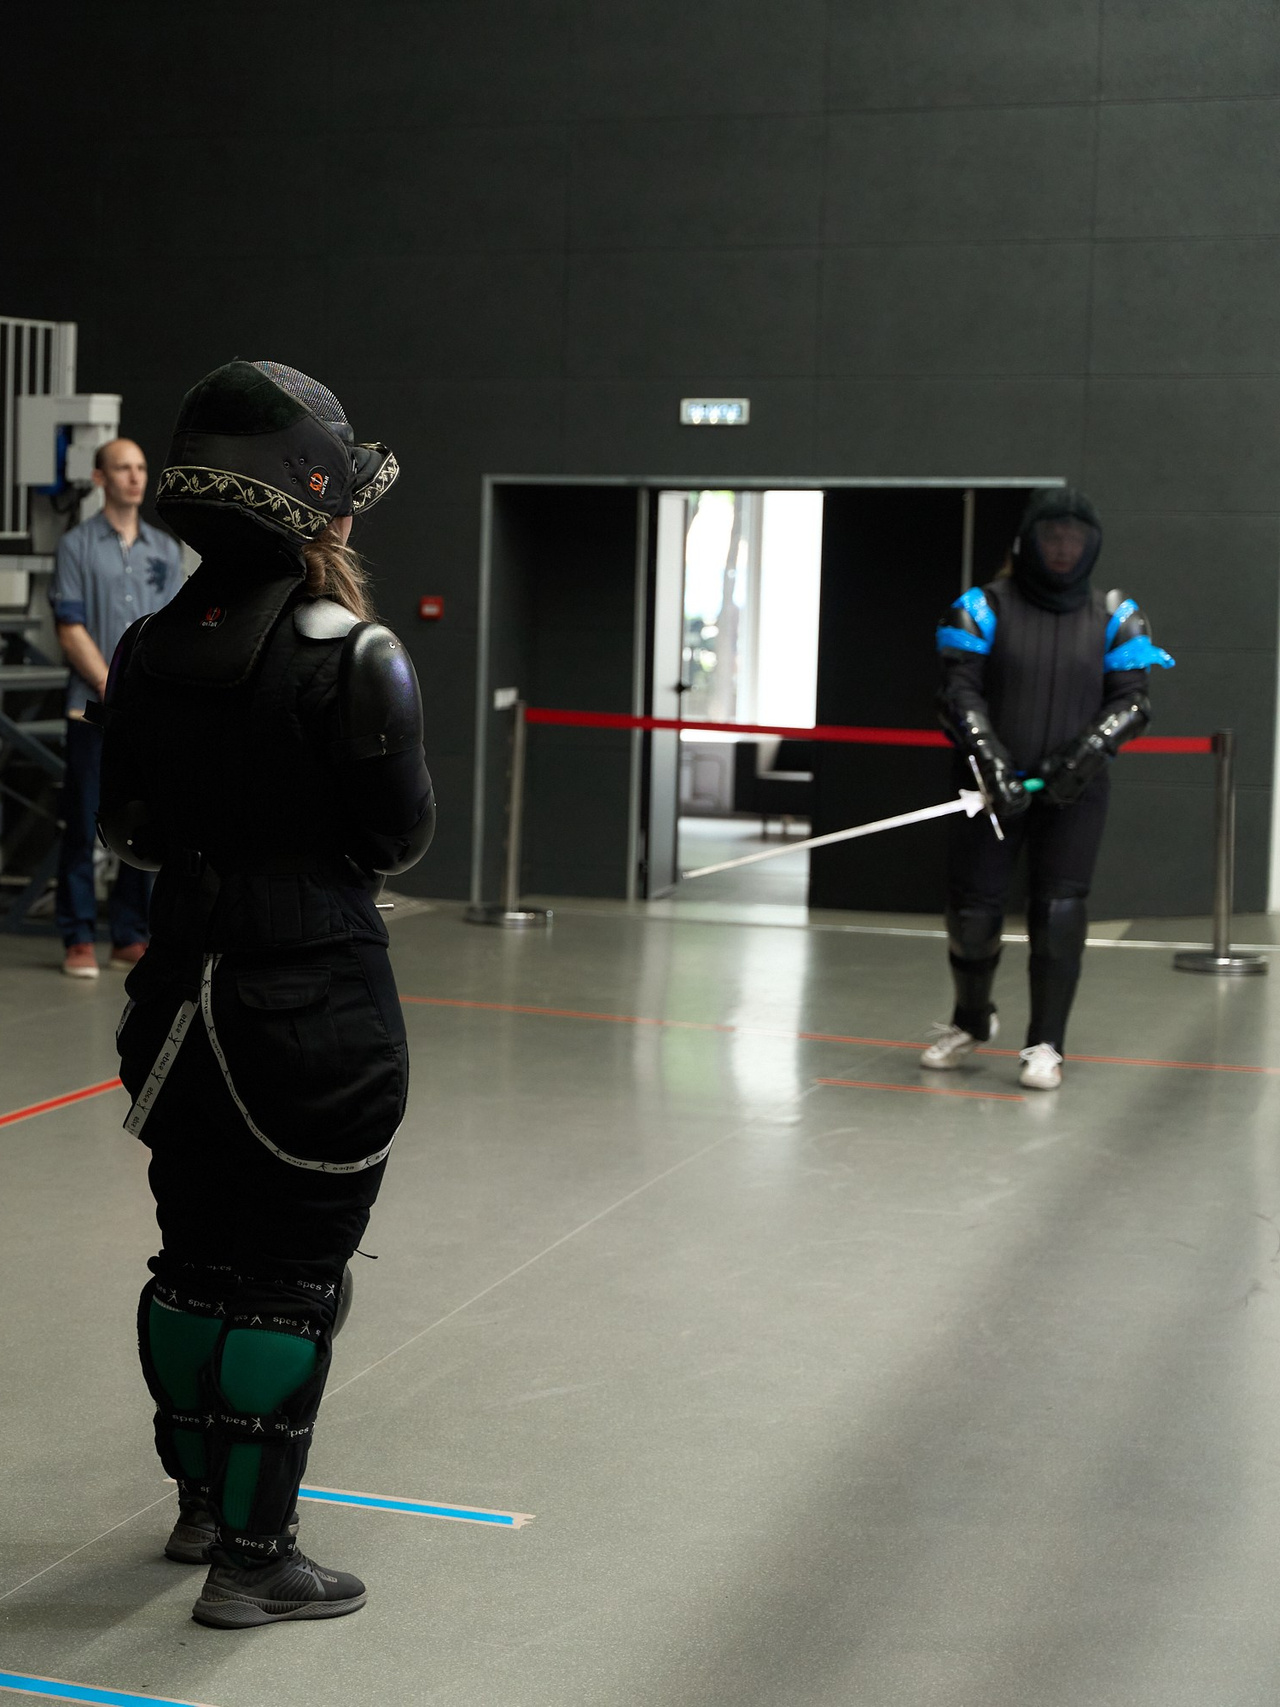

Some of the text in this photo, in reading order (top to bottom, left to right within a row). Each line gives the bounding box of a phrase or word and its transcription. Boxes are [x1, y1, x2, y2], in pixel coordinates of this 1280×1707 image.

[297, 1279, 322, 1291] spes
[188, 1298, 211, 1309] spes
[273, 1316, 298, 1326] spes
[172, 1414, 200, 1424] spes
[220, 1414, 288, 1431] spes sp
[289, 1426, 309, 1438] pes
[234, 1537, 265, 1549] spes
